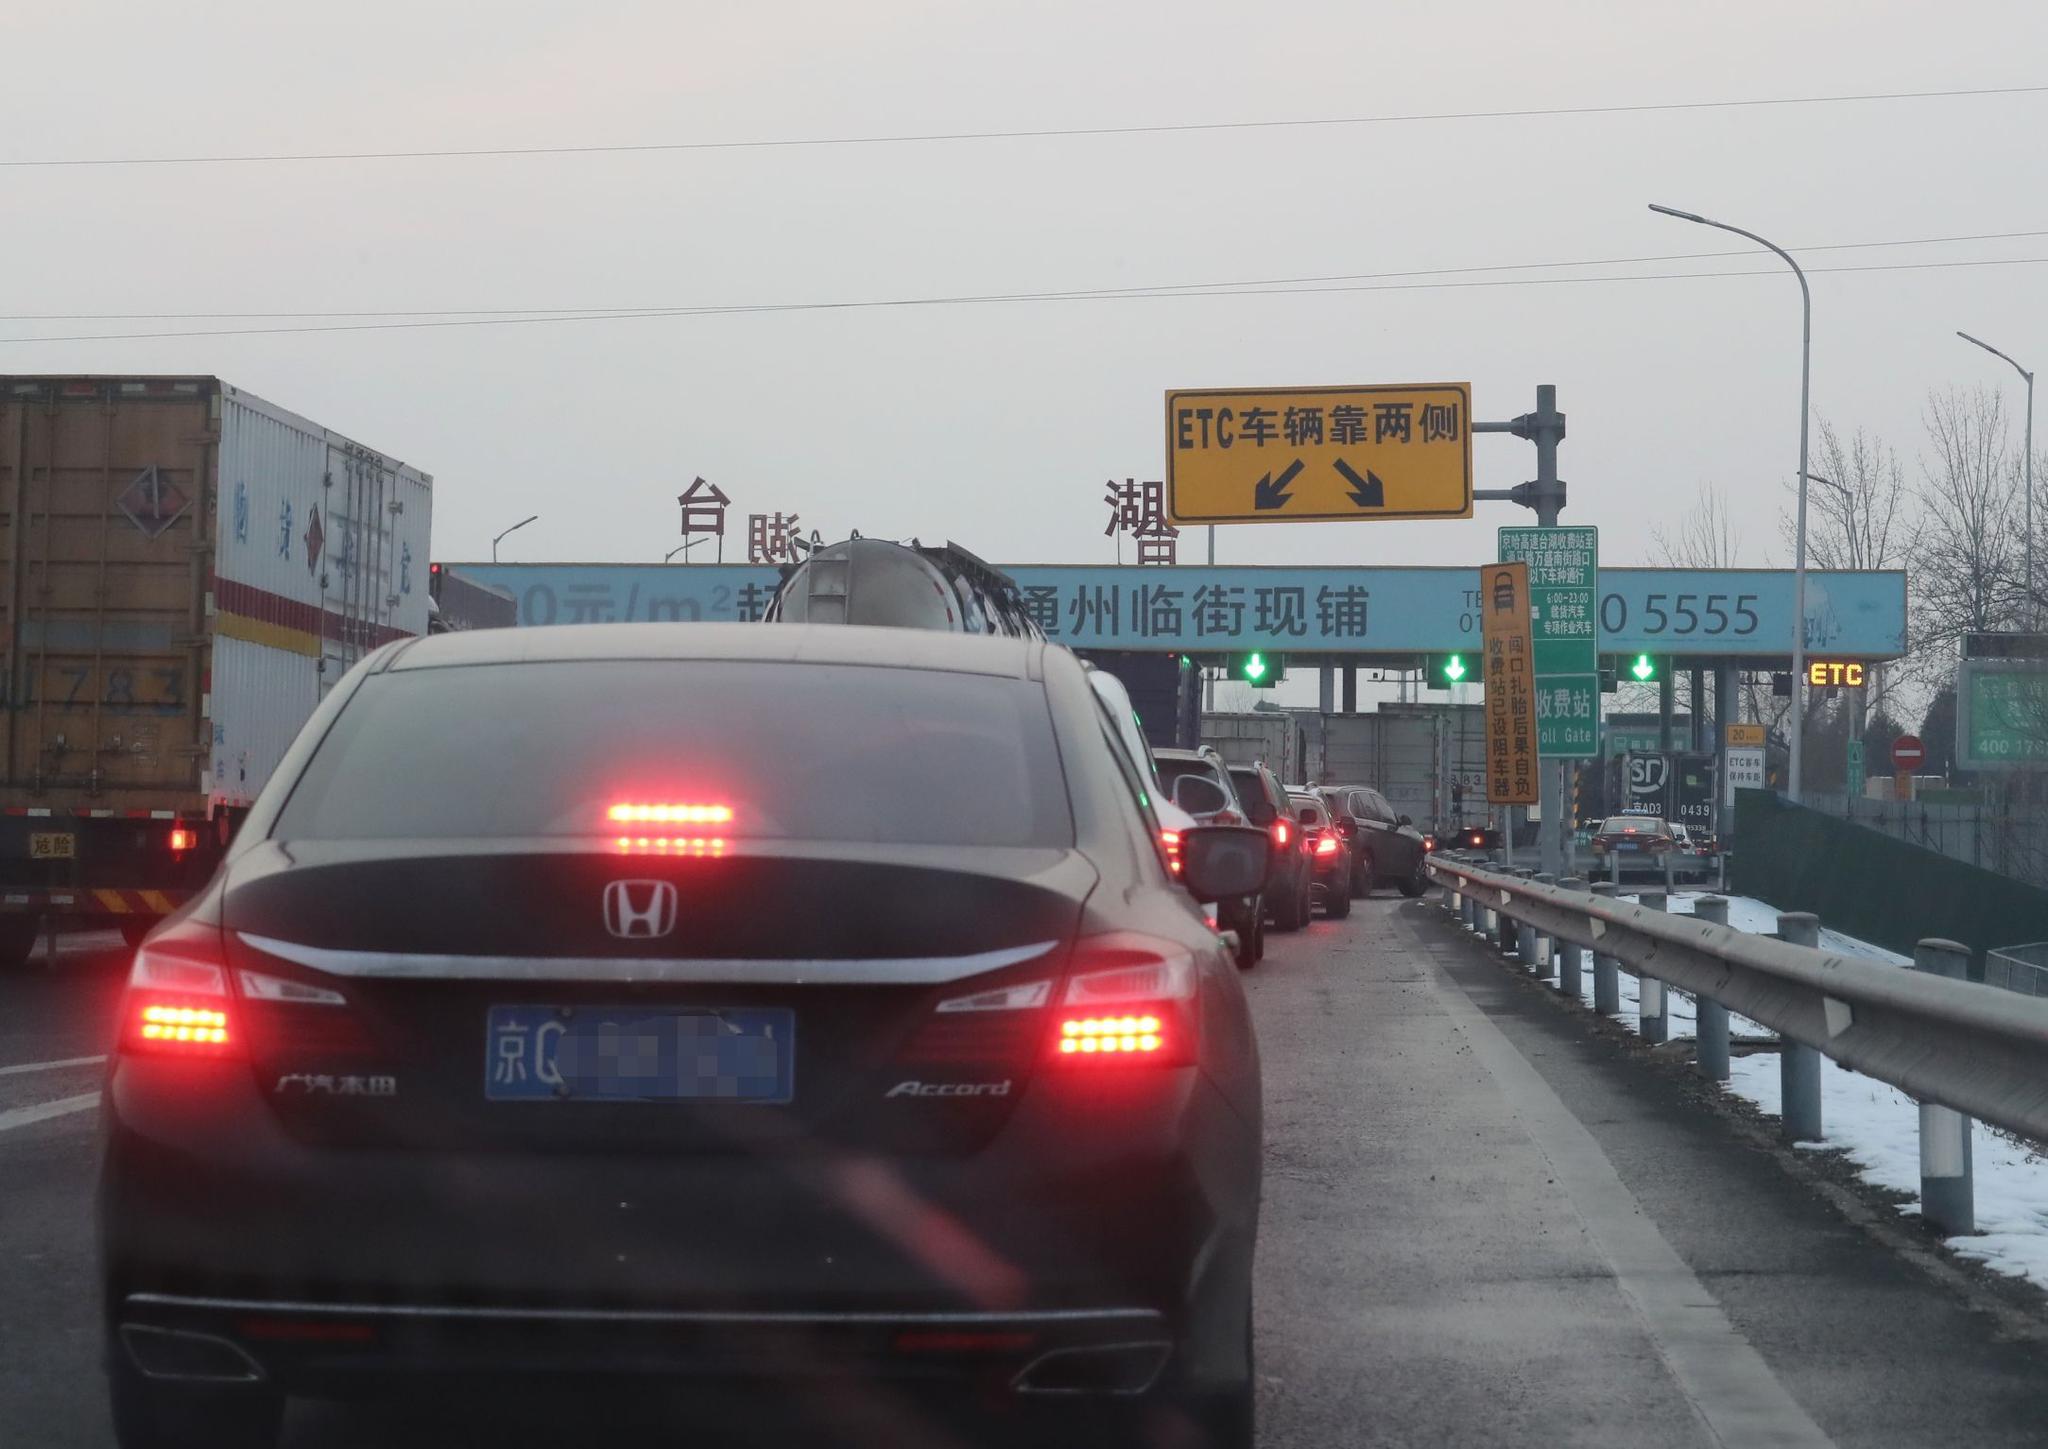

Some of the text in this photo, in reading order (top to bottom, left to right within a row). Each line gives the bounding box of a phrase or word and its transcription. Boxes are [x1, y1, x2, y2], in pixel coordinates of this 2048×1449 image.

[1176, 402, 1459, 449] ETC车辆靠两侧
[678, 476, 1163, 537] 台 湖
[1643, 594, 1759, 635] 5555
[1810, 662, 1863, 686] ETC
[1538, 727, 1591, 743] oll Gate
[1680, 804, 1711, 816] 0439
[34, 836, 72, 856] 危险
[885, 1079, 1012, 1098] Accord
